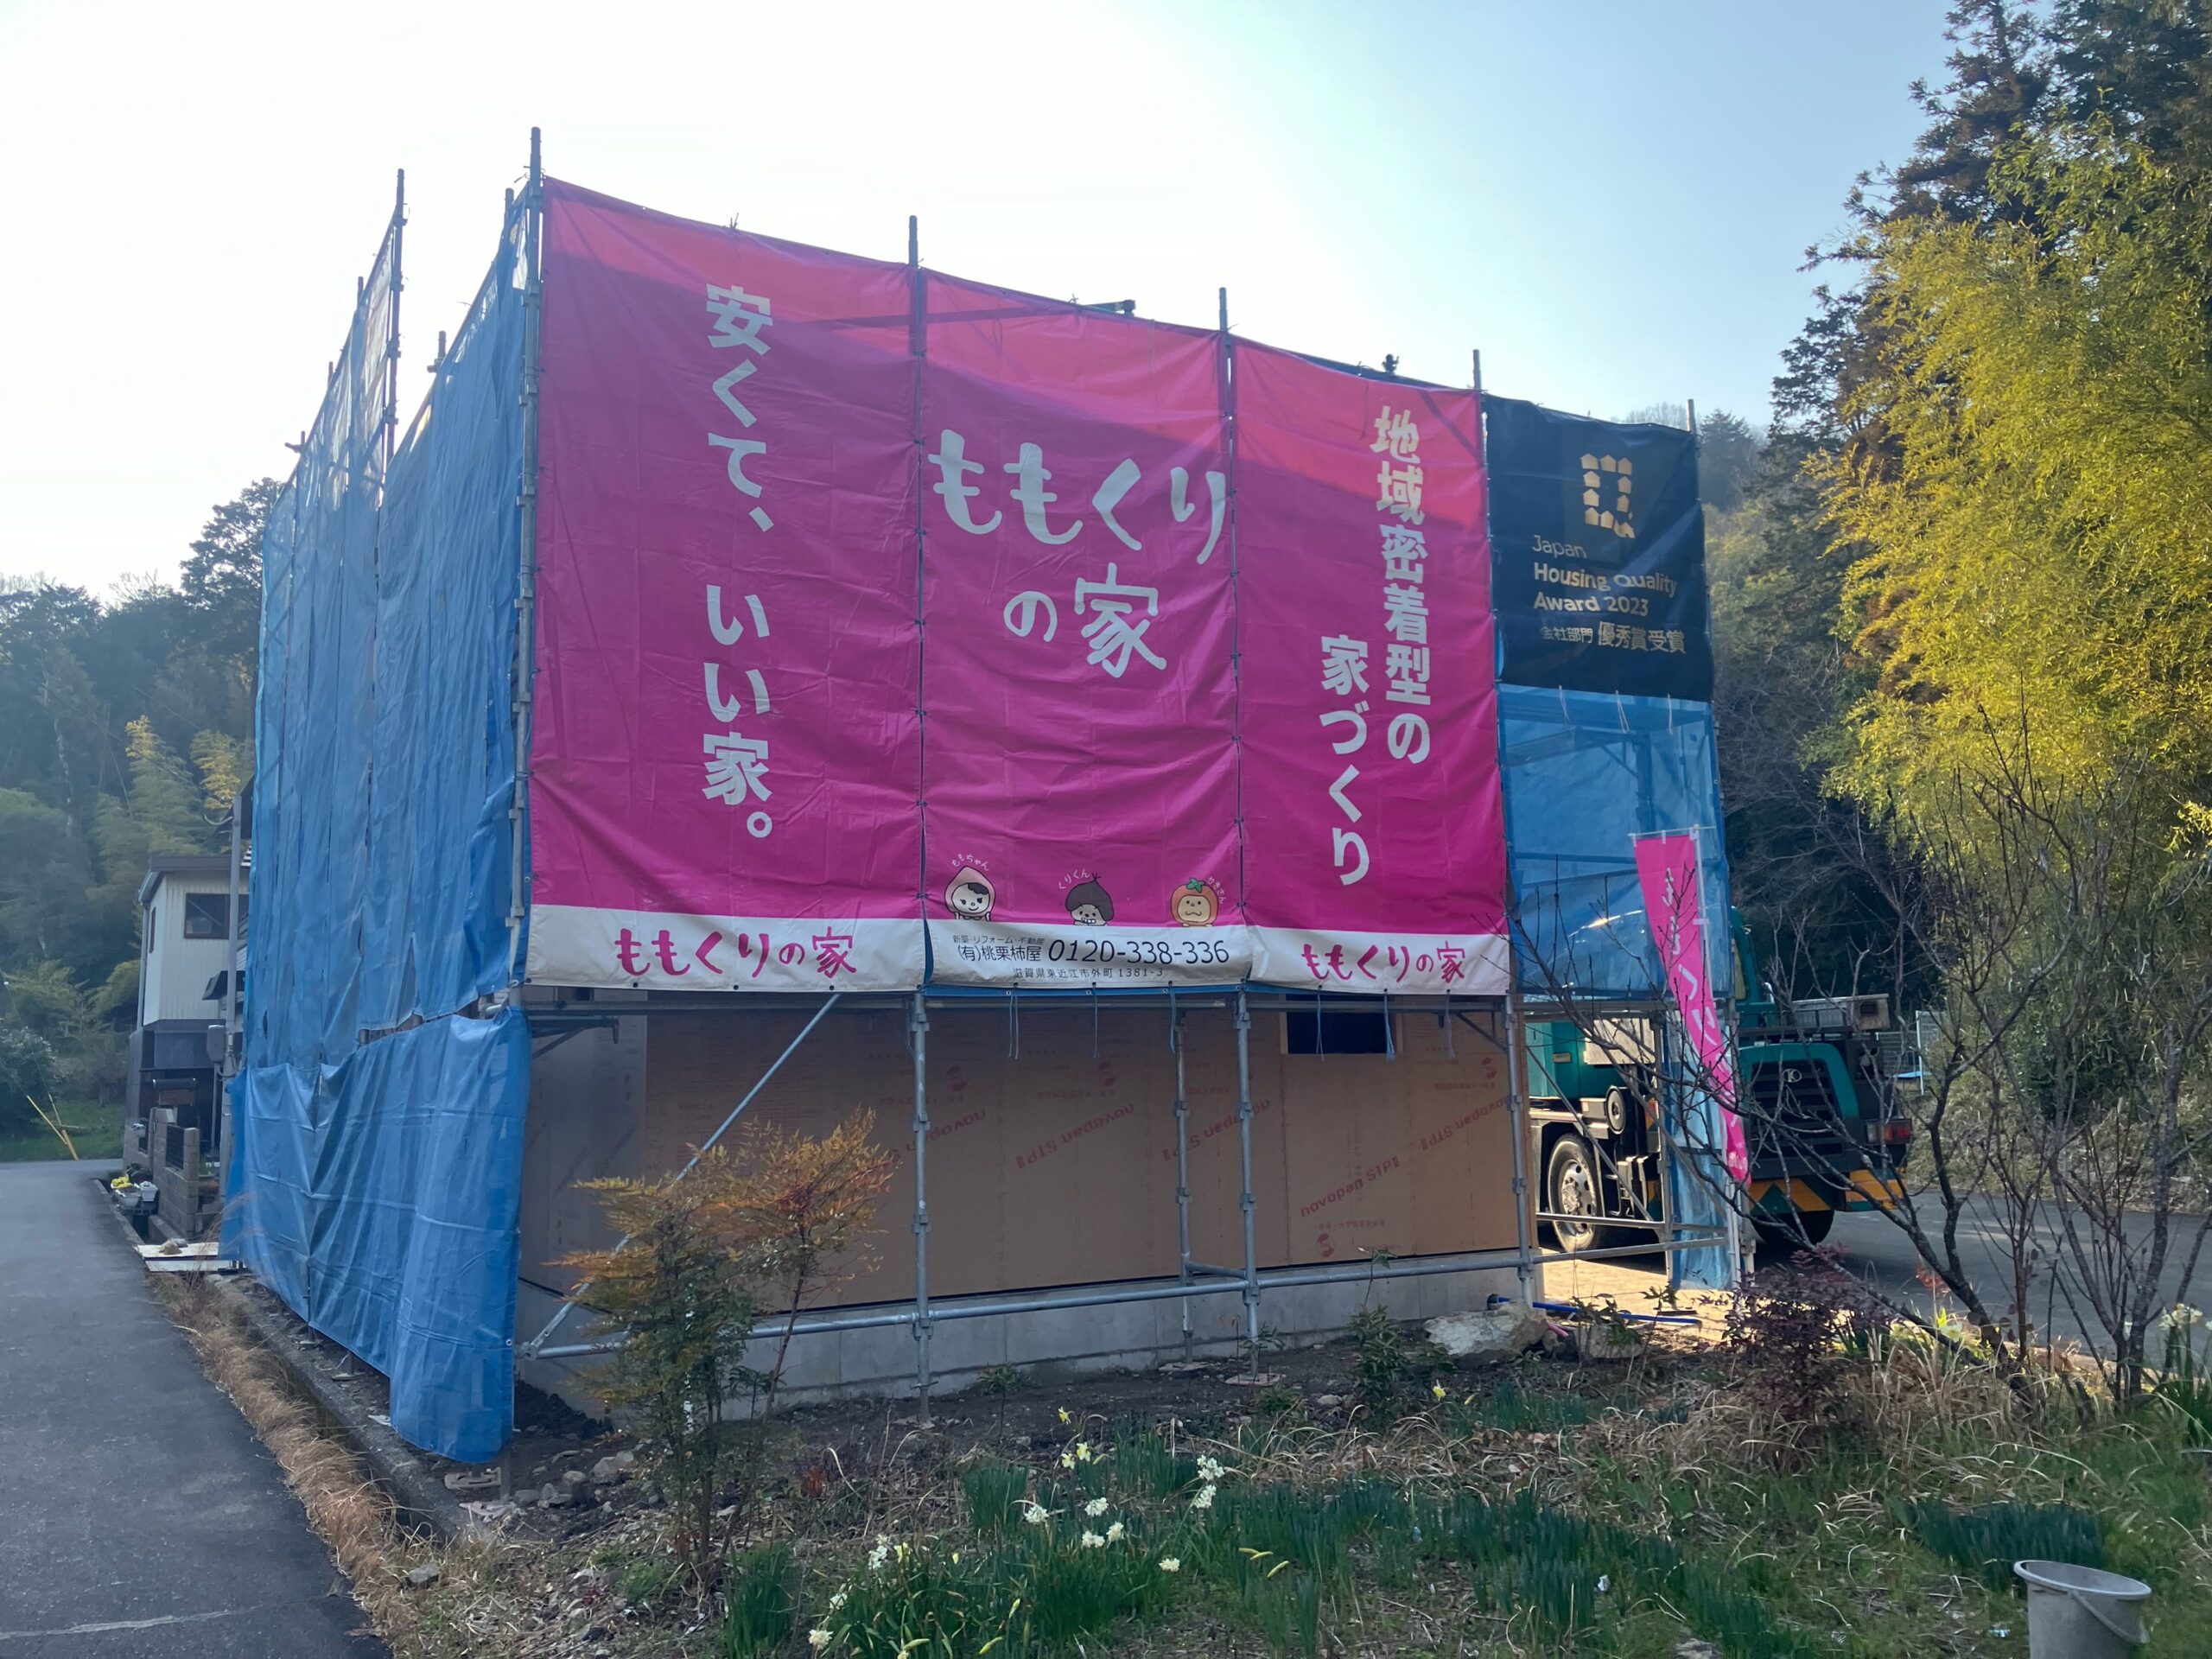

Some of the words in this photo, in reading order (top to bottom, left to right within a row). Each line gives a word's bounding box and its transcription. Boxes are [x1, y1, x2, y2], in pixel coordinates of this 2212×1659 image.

[928, 429, 1226, 564] ももくり
[702, 284, 774, 838] 安くて、いい家。
[1532, 535, 1587, 558] Japan
[1370, 405, 1432, 764] 地域密着型の
[1534, 562, 1611, 591] Housing
[1613, 573, 1678, 598] Quality
[1003, 562, 1166, 678] の家
[1534, 591, 1600, 612] Award
[1603, 595, 1649, 617] 2023
[1598, 620, 1687, 654] 優秀賞受賞
[1319, 634, 1370, 886] 家づくり
[952, 853, 989, 872] ももちゃん
[1058, 868, 1090, 890] くりくん
[614, 926, 857, 978] ももくりの家
[1048, 939, 1230, 965] 0120-338-336
[1301, 940, 1466, 983] ももくりの家
[1118, 968, 1164, 977] 1381-3
